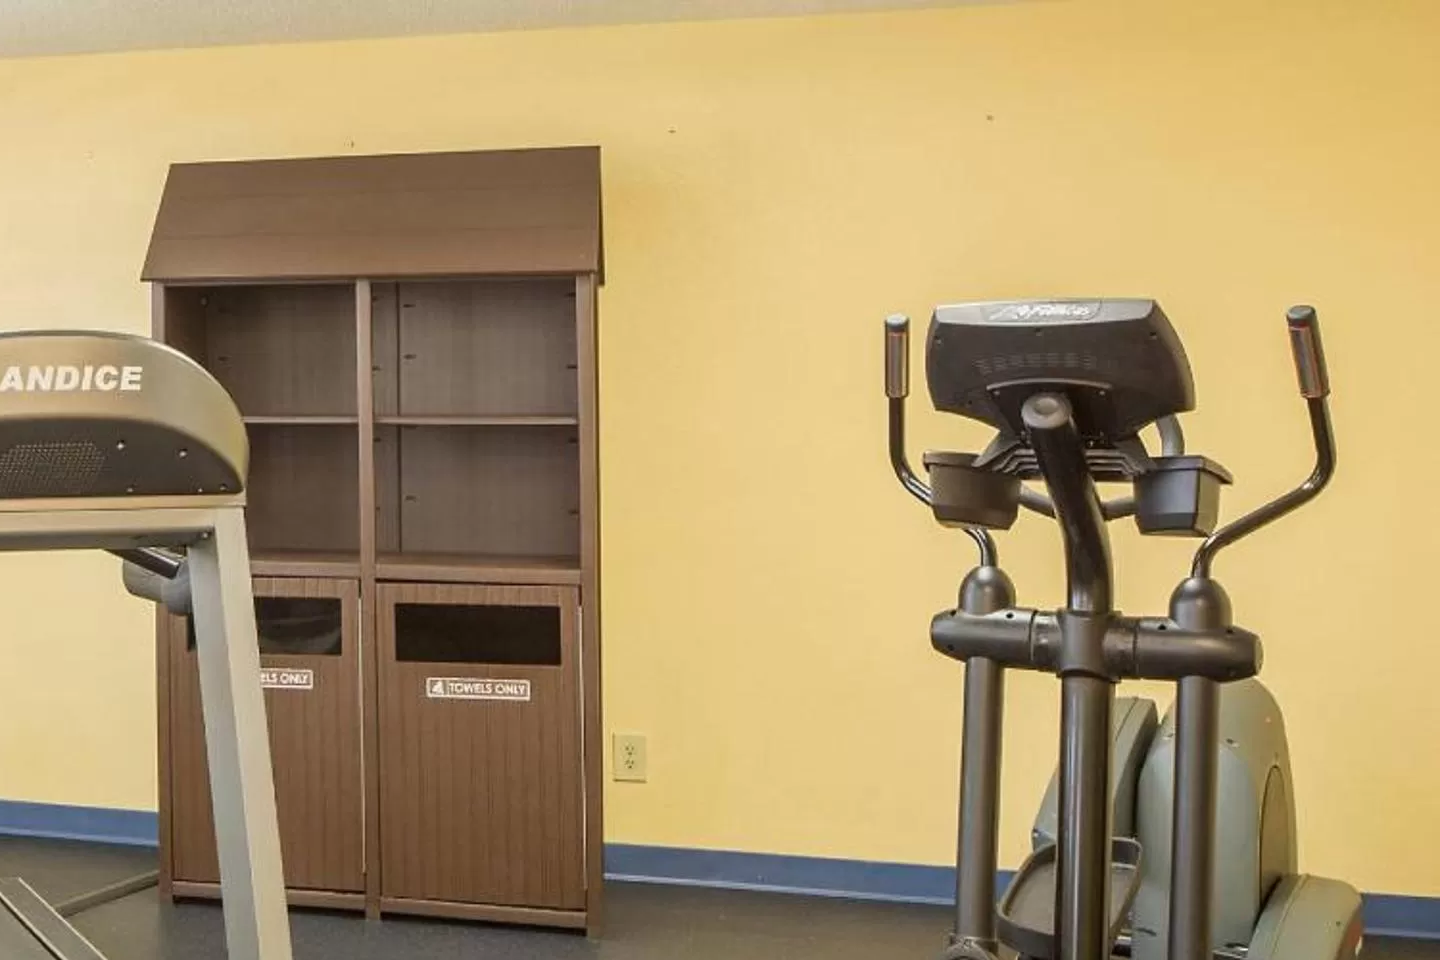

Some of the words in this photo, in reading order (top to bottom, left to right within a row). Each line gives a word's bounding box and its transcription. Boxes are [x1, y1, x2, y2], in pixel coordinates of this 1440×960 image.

[260, 673, 278, 683] ELS
[280, 673, 308, 685] ONLY
[448, 682, 492, 695] TOWELS
[495, 683, 525, 695] ONLY
